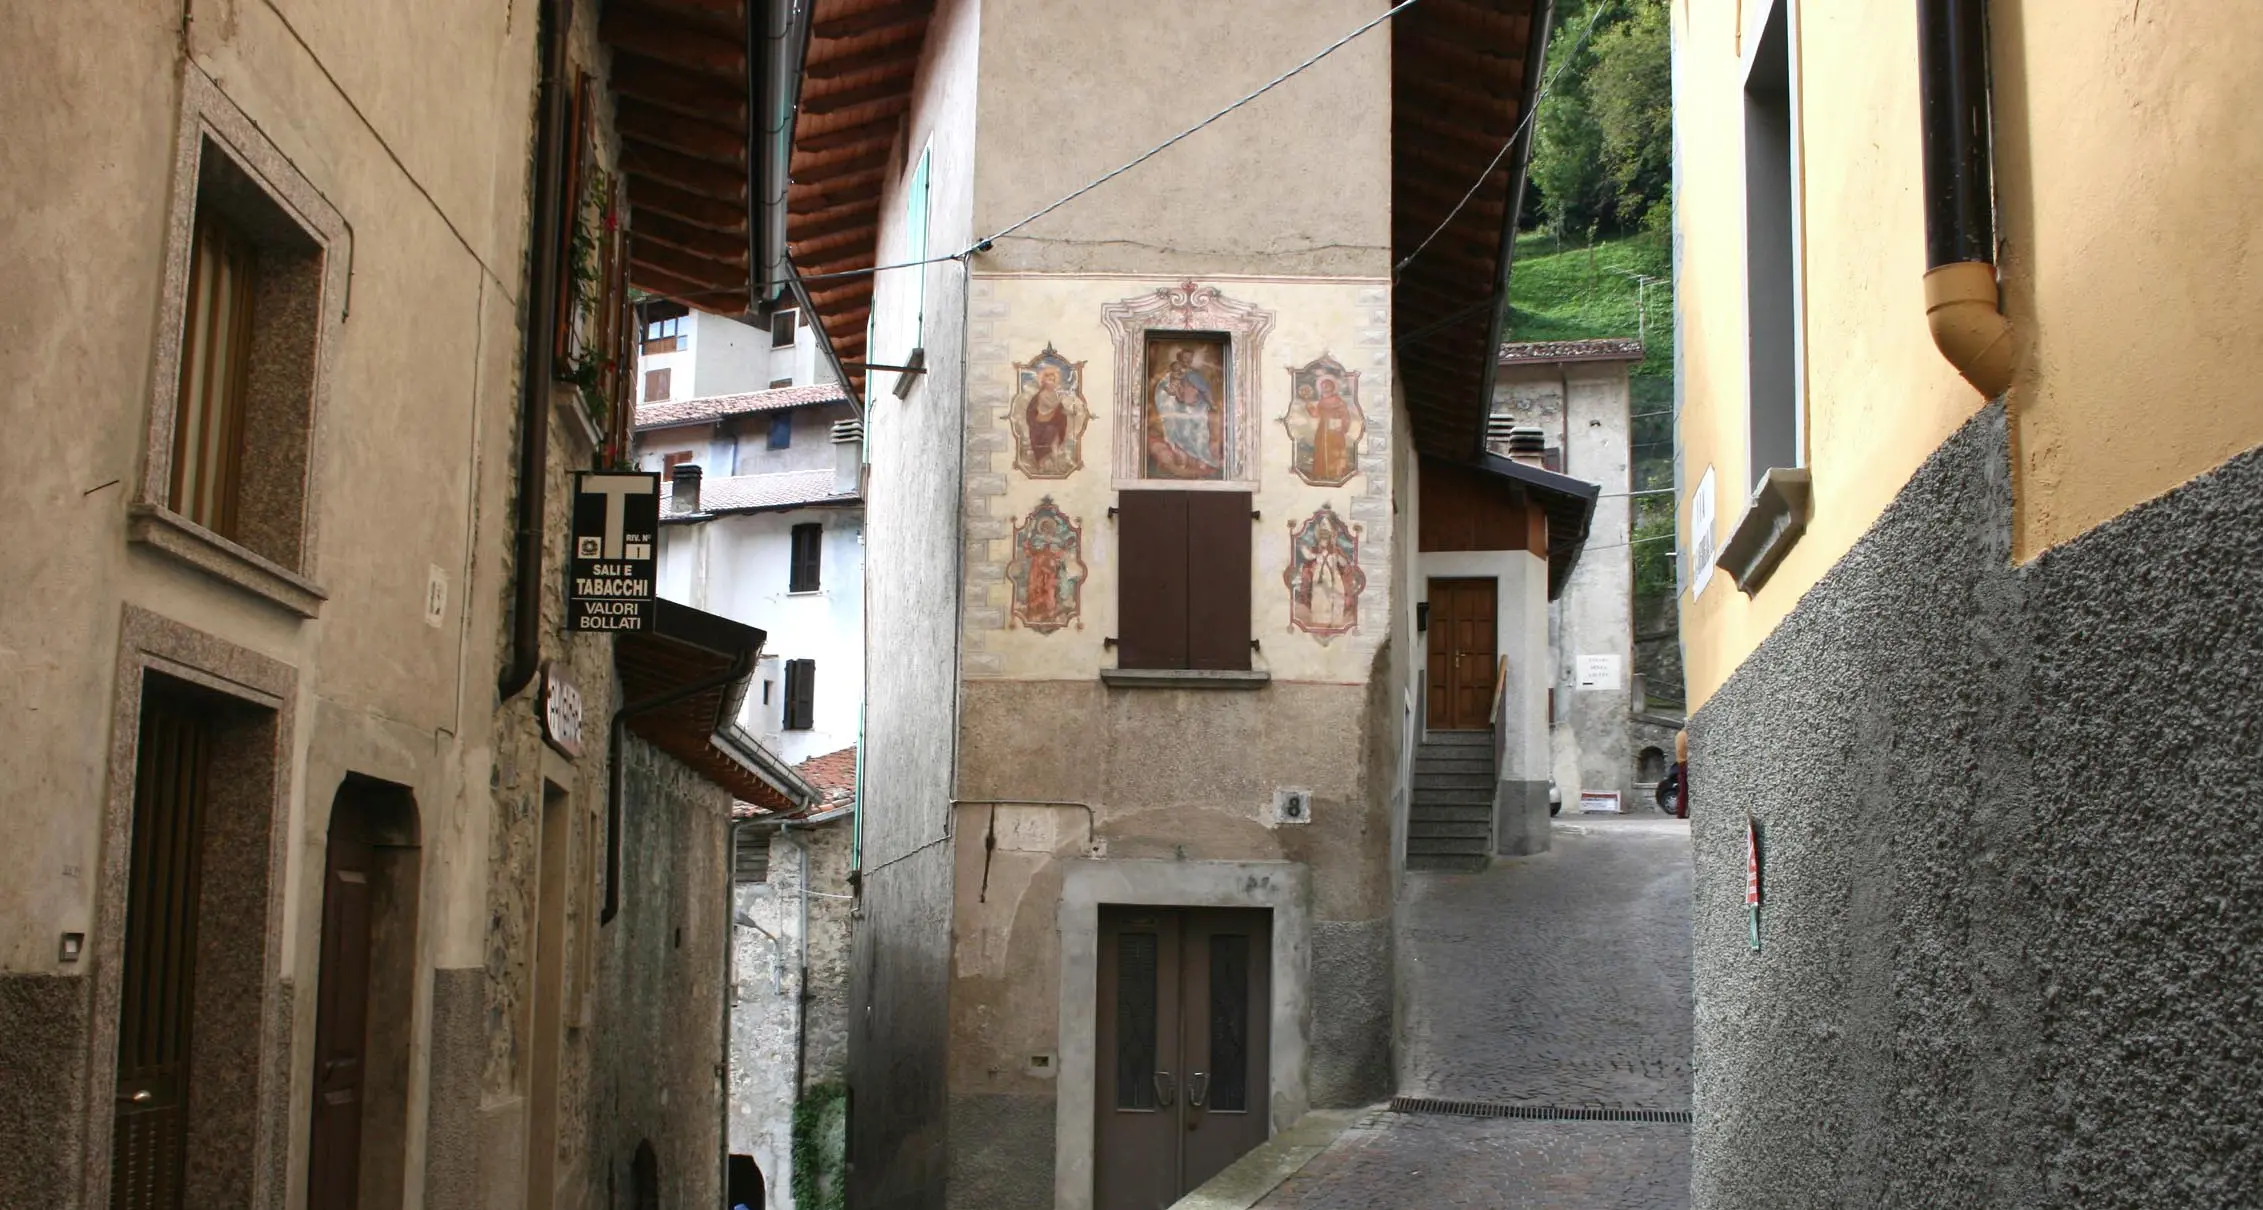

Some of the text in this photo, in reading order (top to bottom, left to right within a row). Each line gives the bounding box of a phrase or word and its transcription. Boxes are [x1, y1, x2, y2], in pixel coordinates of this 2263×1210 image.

[582, 475, 653, 560] T
[626, 534, 641, 542] RIV.
[593, 564, 632, 576] SALI E
[576, 578, 648, 597] TABACCHI
[585, 602, 638, 615] VALORI
[580, 616, 641, 630] BOLLATI
[1288, 797, 1300, 817] 8
